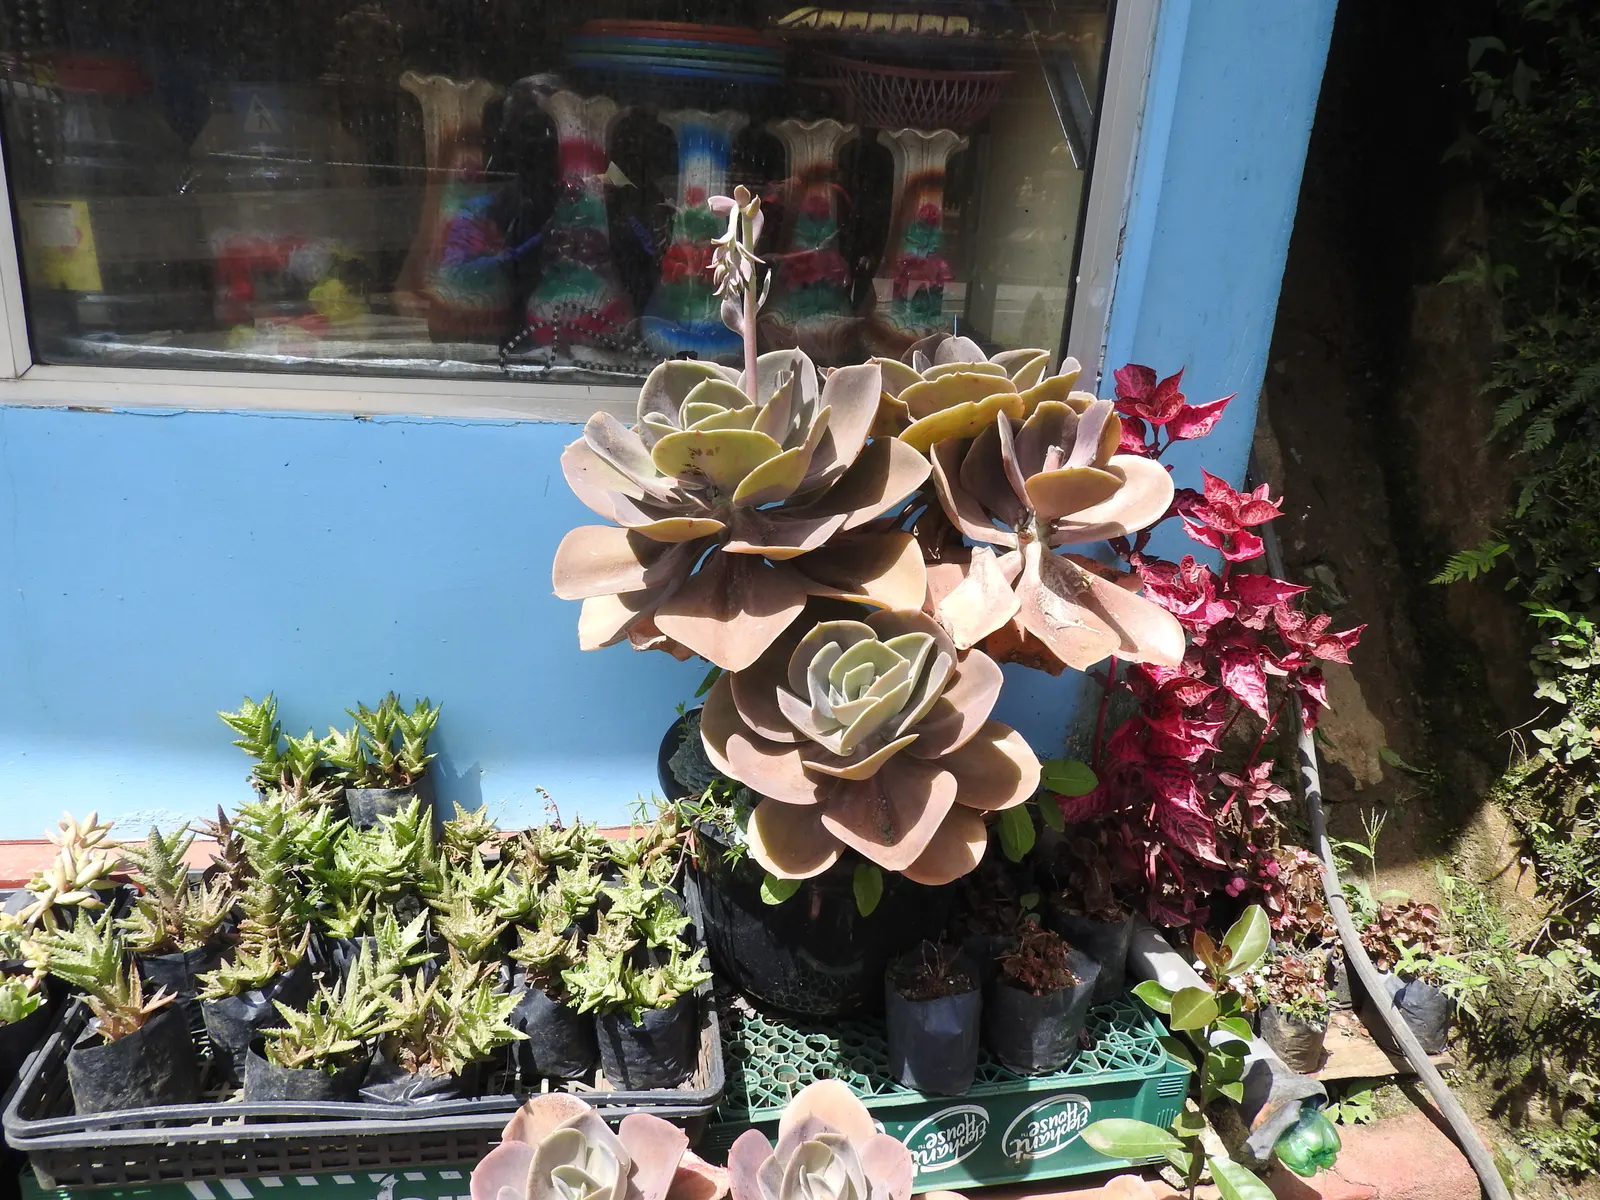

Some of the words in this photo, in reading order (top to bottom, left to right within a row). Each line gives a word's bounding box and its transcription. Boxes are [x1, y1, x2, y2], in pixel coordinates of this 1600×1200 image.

[924, 1112, 977, 1149] House
[1009, 1107, 1089, 1164] Elephant
[1027, 1102, 1079, 1137] House
